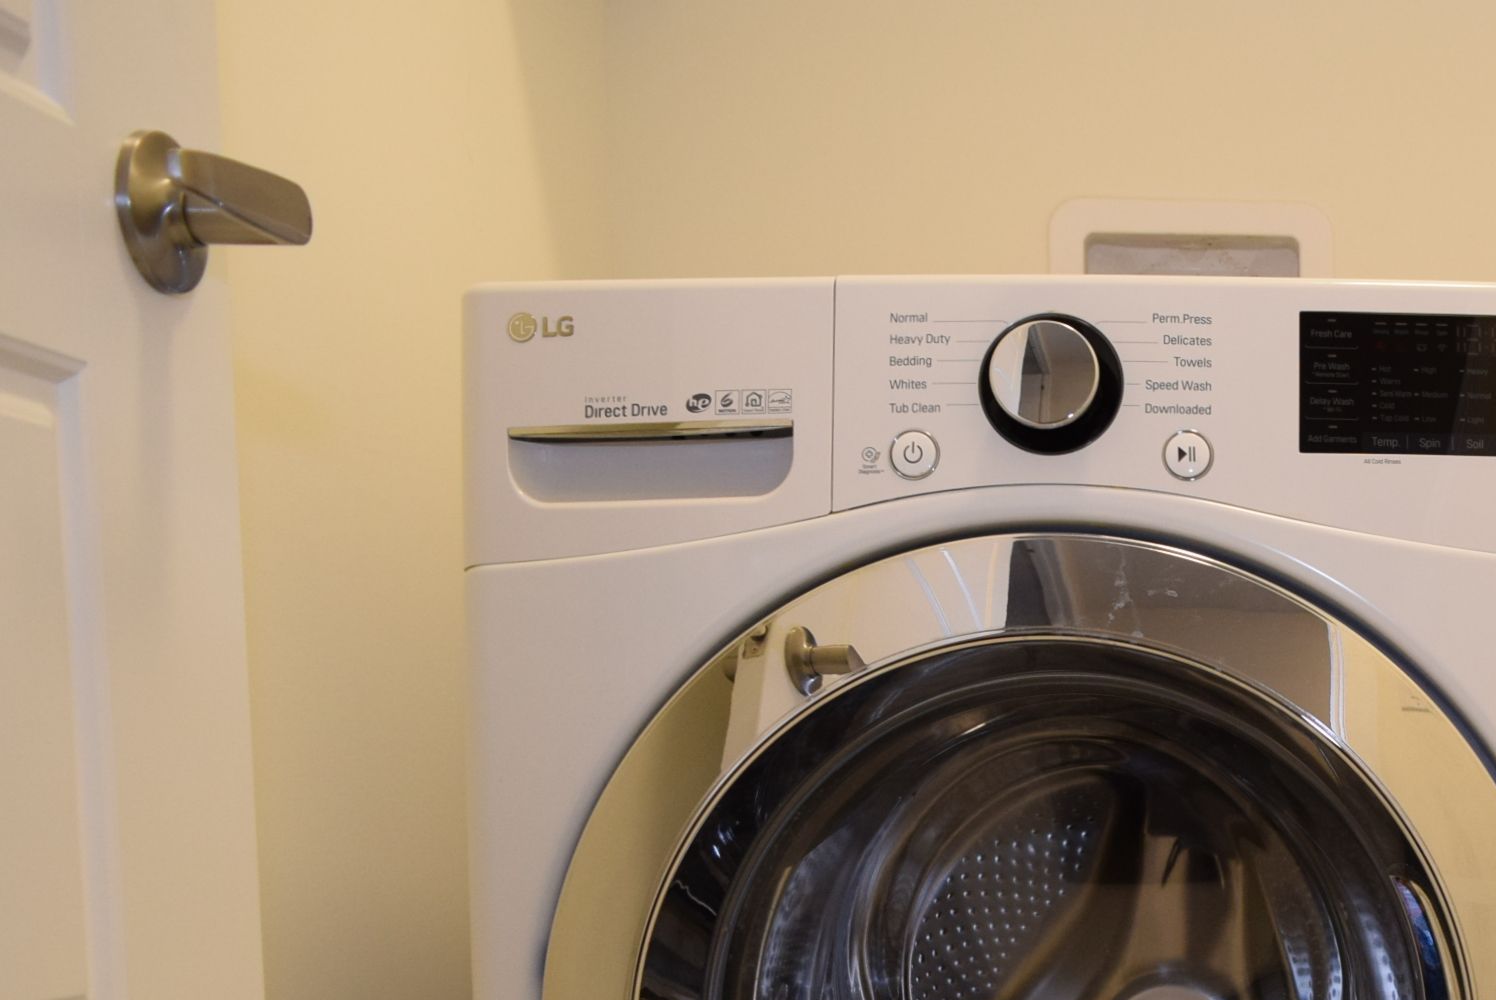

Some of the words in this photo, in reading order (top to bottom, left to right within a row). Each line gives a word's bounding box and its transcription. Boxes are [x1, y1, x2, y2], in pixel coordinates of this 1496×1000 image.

[889, 312, 928, 323] Normal
[889, 334, 923, 346] Heavy
[926, 333, 951, 346] Duty
[1163, 334, 1212, 346] Delicates
[889, 356, 932, 368] Bedding
[1173, 356, 1212, 368] Towels
[889, 379, 927, 389] Whites
[1145, 379, 1179, 392] Speed
[1181, 379, 1212, 391] Wash
[584, 404, 628, 419] Direct
[631, 403, 668, 417] Drive
[889, 402, 909, 413] Tub
[911, 402, 941, 413] Clean
[1144, 402, 1212, 415] Downloaded
[1418, 437, 1441, 450] Spin
[1465, 439, 1484, 449] Soil
